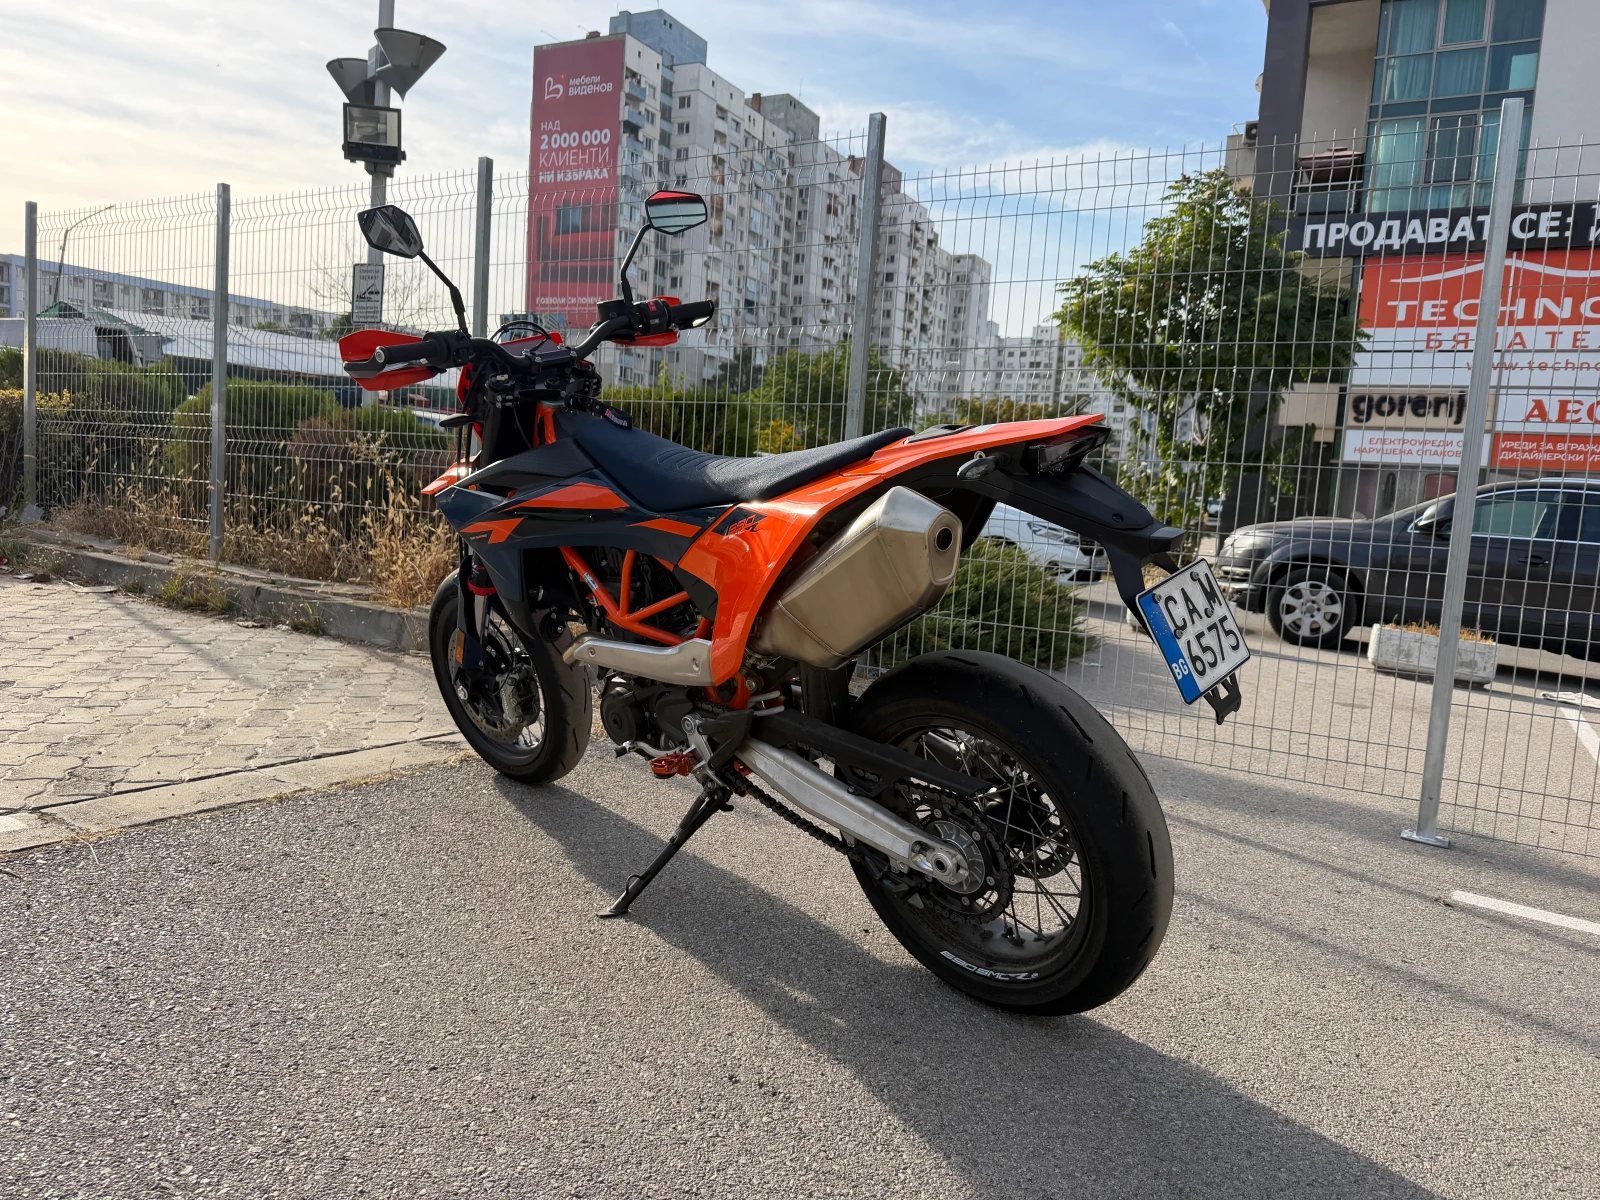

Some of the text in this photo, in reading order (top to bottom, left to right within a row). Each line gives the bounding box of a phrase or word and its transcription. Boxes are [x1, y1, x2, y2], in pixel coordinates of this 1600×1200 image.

[541, 120, 560, 132] НАД
[540, 147, 609, 168] КЛИЕНТИ
[539, 170, 554, 184] НИ
[1305, 214, 1490, 250] ПРОДАВАТ
[1511, 210, 1573, 240] СЕ:
[1425, 331, 1600, 350] БЯА ТЕ
[1352, 390, 1466, 425] gorenj
[1369, 437, 1454, 448] ЕЛЕКТРОУРЕДИ
[1501, 441, 1536, 450] УРЕДИ
[1540, 442, 1554, 450] ЗА
[1354, 447, 1462, 458] НАРУШЕНА ОПАКОВ
[1500, 450, 1584, 462] ДИЗАЙНЕРСКИ
[1187, 615, 1240, 677] 6575
[1172, 658, 1188, 680] BG
